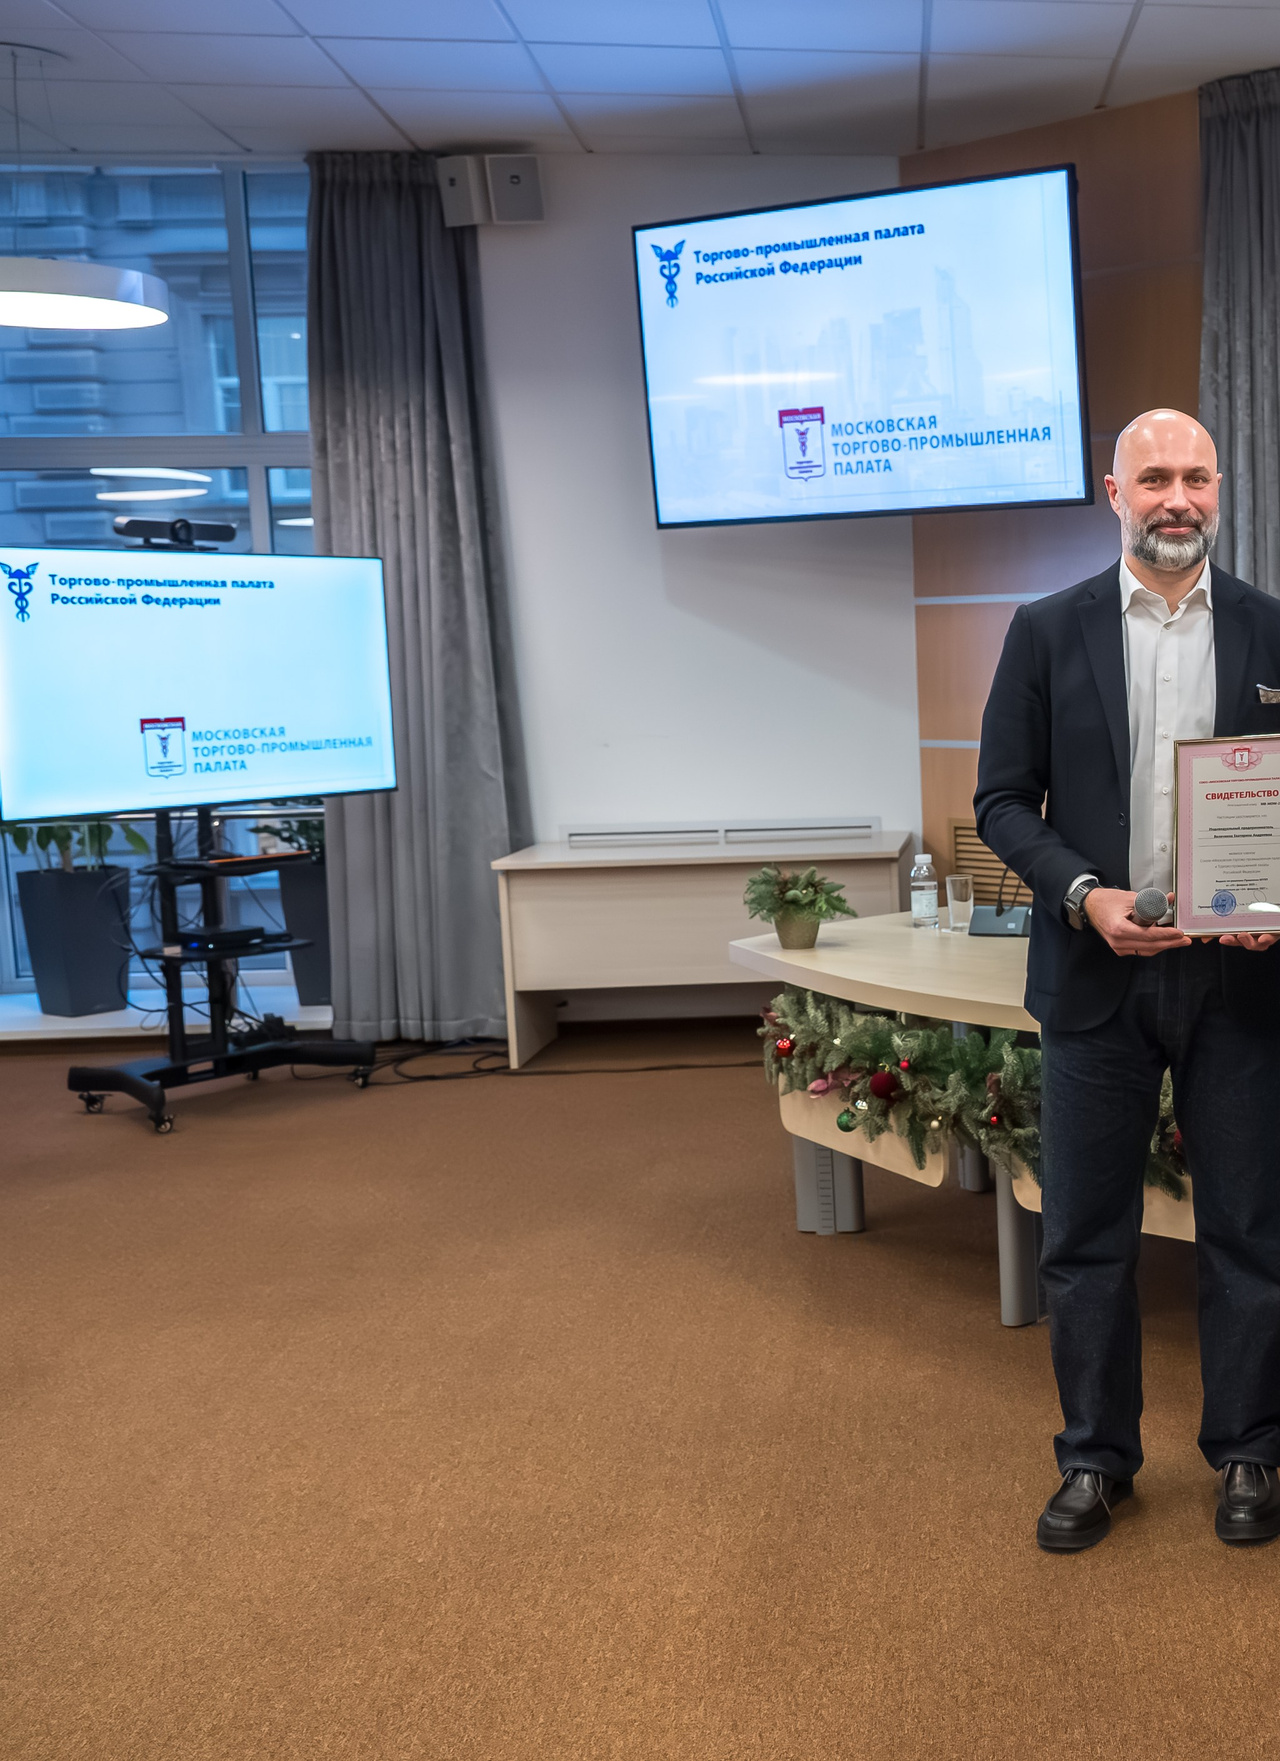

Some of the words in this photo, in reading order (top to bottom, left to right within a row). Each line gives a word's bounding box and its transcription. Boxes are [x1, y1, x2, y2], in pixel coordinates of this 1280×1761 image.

[693, 230, 870, 266] Торгово-промышленная
[874, 223, 925, 241] палата
[695, 262, 776, 285] Российской
[779, 254, 863, 275] Федерации
[830, 415, 938, 438] МОСКОВСКАЯ
[832, 426, 1052, 456] ТОРГОВО-ПРОМЫШЛЕННАЯ
[833, 458, 893, 476] ПАЛАТА
[48, 573, 227, 589] Торгово-промышленная
[231, 579, 275, 589] палата
[50, 592, 137, 605] Российской
[141, 593, 221, 608] Федерации
[191, 726, 286, 743] МОСКОВСКАЯ
[192, 736, 373, 758] ТОРГОВО-ПРОМЫШЛЕННАЯ
[194, 759, 248, 774] ПАЛАТА
[1205, 789, 1280, 801] СВИДЕТЕЛЬСТВО
